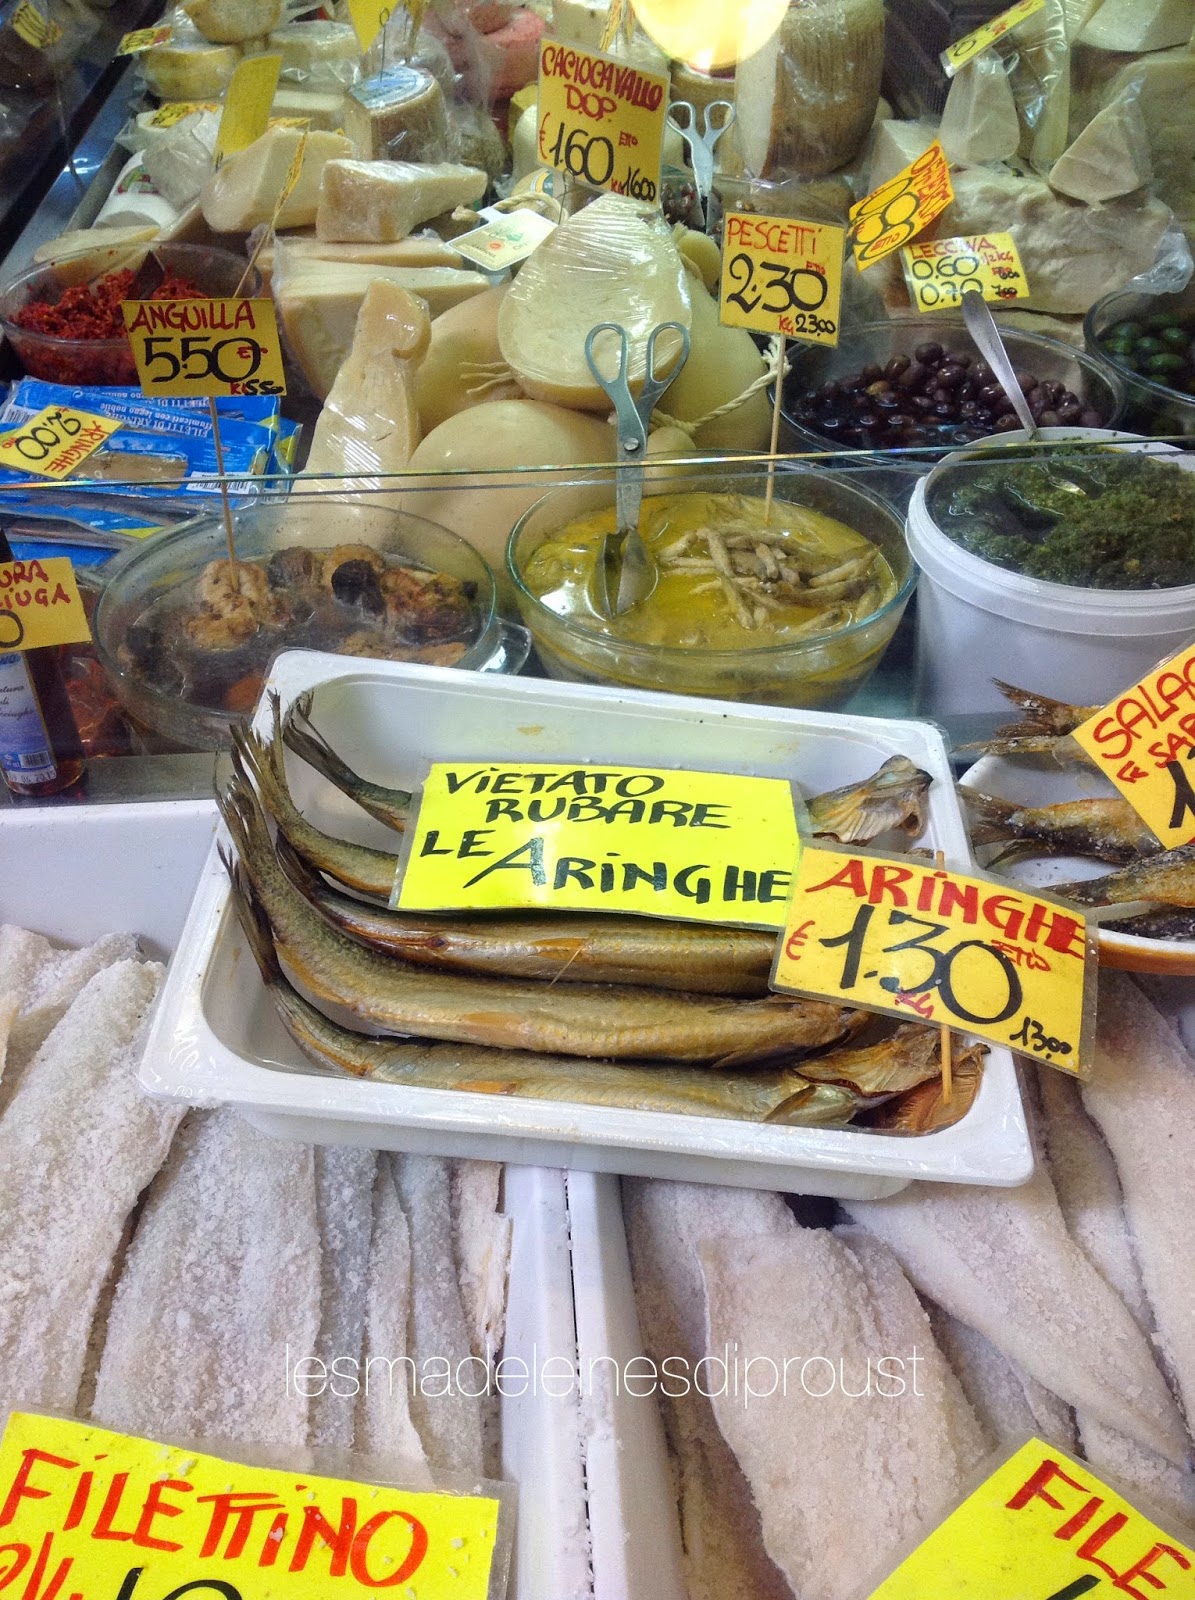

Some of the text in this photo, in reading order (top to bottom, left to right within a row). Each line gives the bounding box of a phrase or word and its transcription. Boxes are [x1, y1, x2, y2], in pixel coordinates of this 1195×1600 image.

[542, 46, 663, 112] CACIOCAVALLO
[549, 122, 614, 186] 1.60
[727, 217, 823, 256] PESCETTI
[909, 237, 997, 260] LECCNA
[727, 253, 828, 314] 2.30
[912, 255, 979, 280] 0.60
[129, 300, 256, 335] ANGUILLA
[143, 337, 261, 384] 5.50
[0, 583, 71, 609] IUGA
[445, 767, 665, 797] VIETATO
[485, 797, 732, 829] RUBARE
[420, 829, 792, 904] LE ARINGHE
[805, 859, 1086, 959] ARINGHE
[818, 904, 1023, 1024] 1.30
[0, 1448, 429, 1588] FILETTINO
